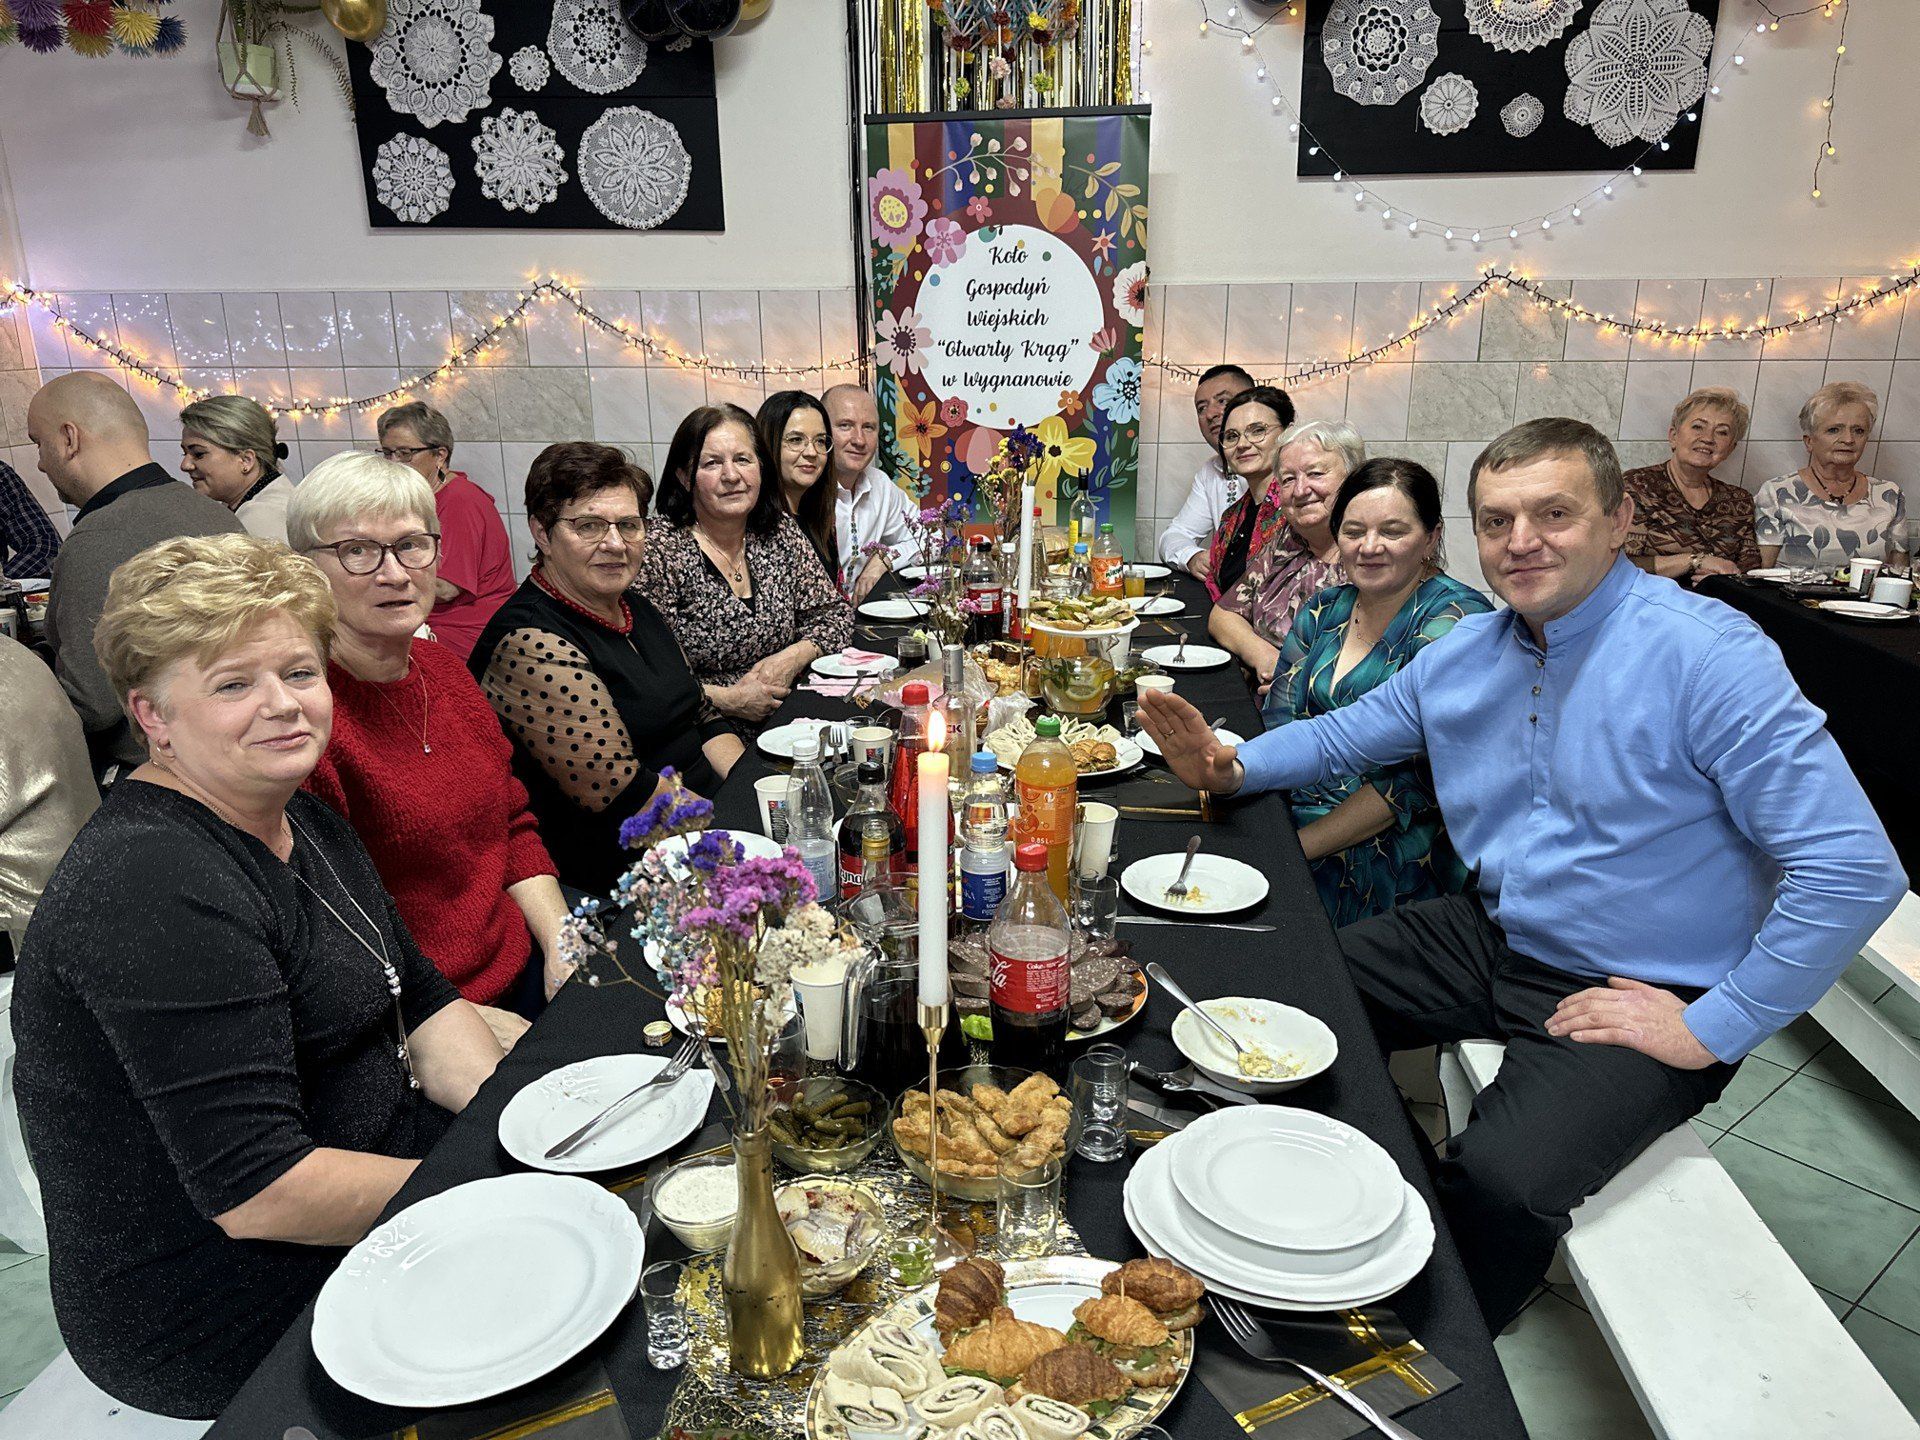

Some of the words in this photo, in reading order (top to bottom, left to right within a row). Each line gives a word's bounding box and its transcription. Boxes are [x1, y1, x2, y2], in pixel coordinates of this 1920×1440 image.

[989, 245, 1028, 265] Koło
[966, 277, 1049, 302] Gospodyń
[967, 309, 1049, 332] Wiejskich
[942, 375, 957, 387] w
[963, 371, 1073, 393] Wygnanowie
